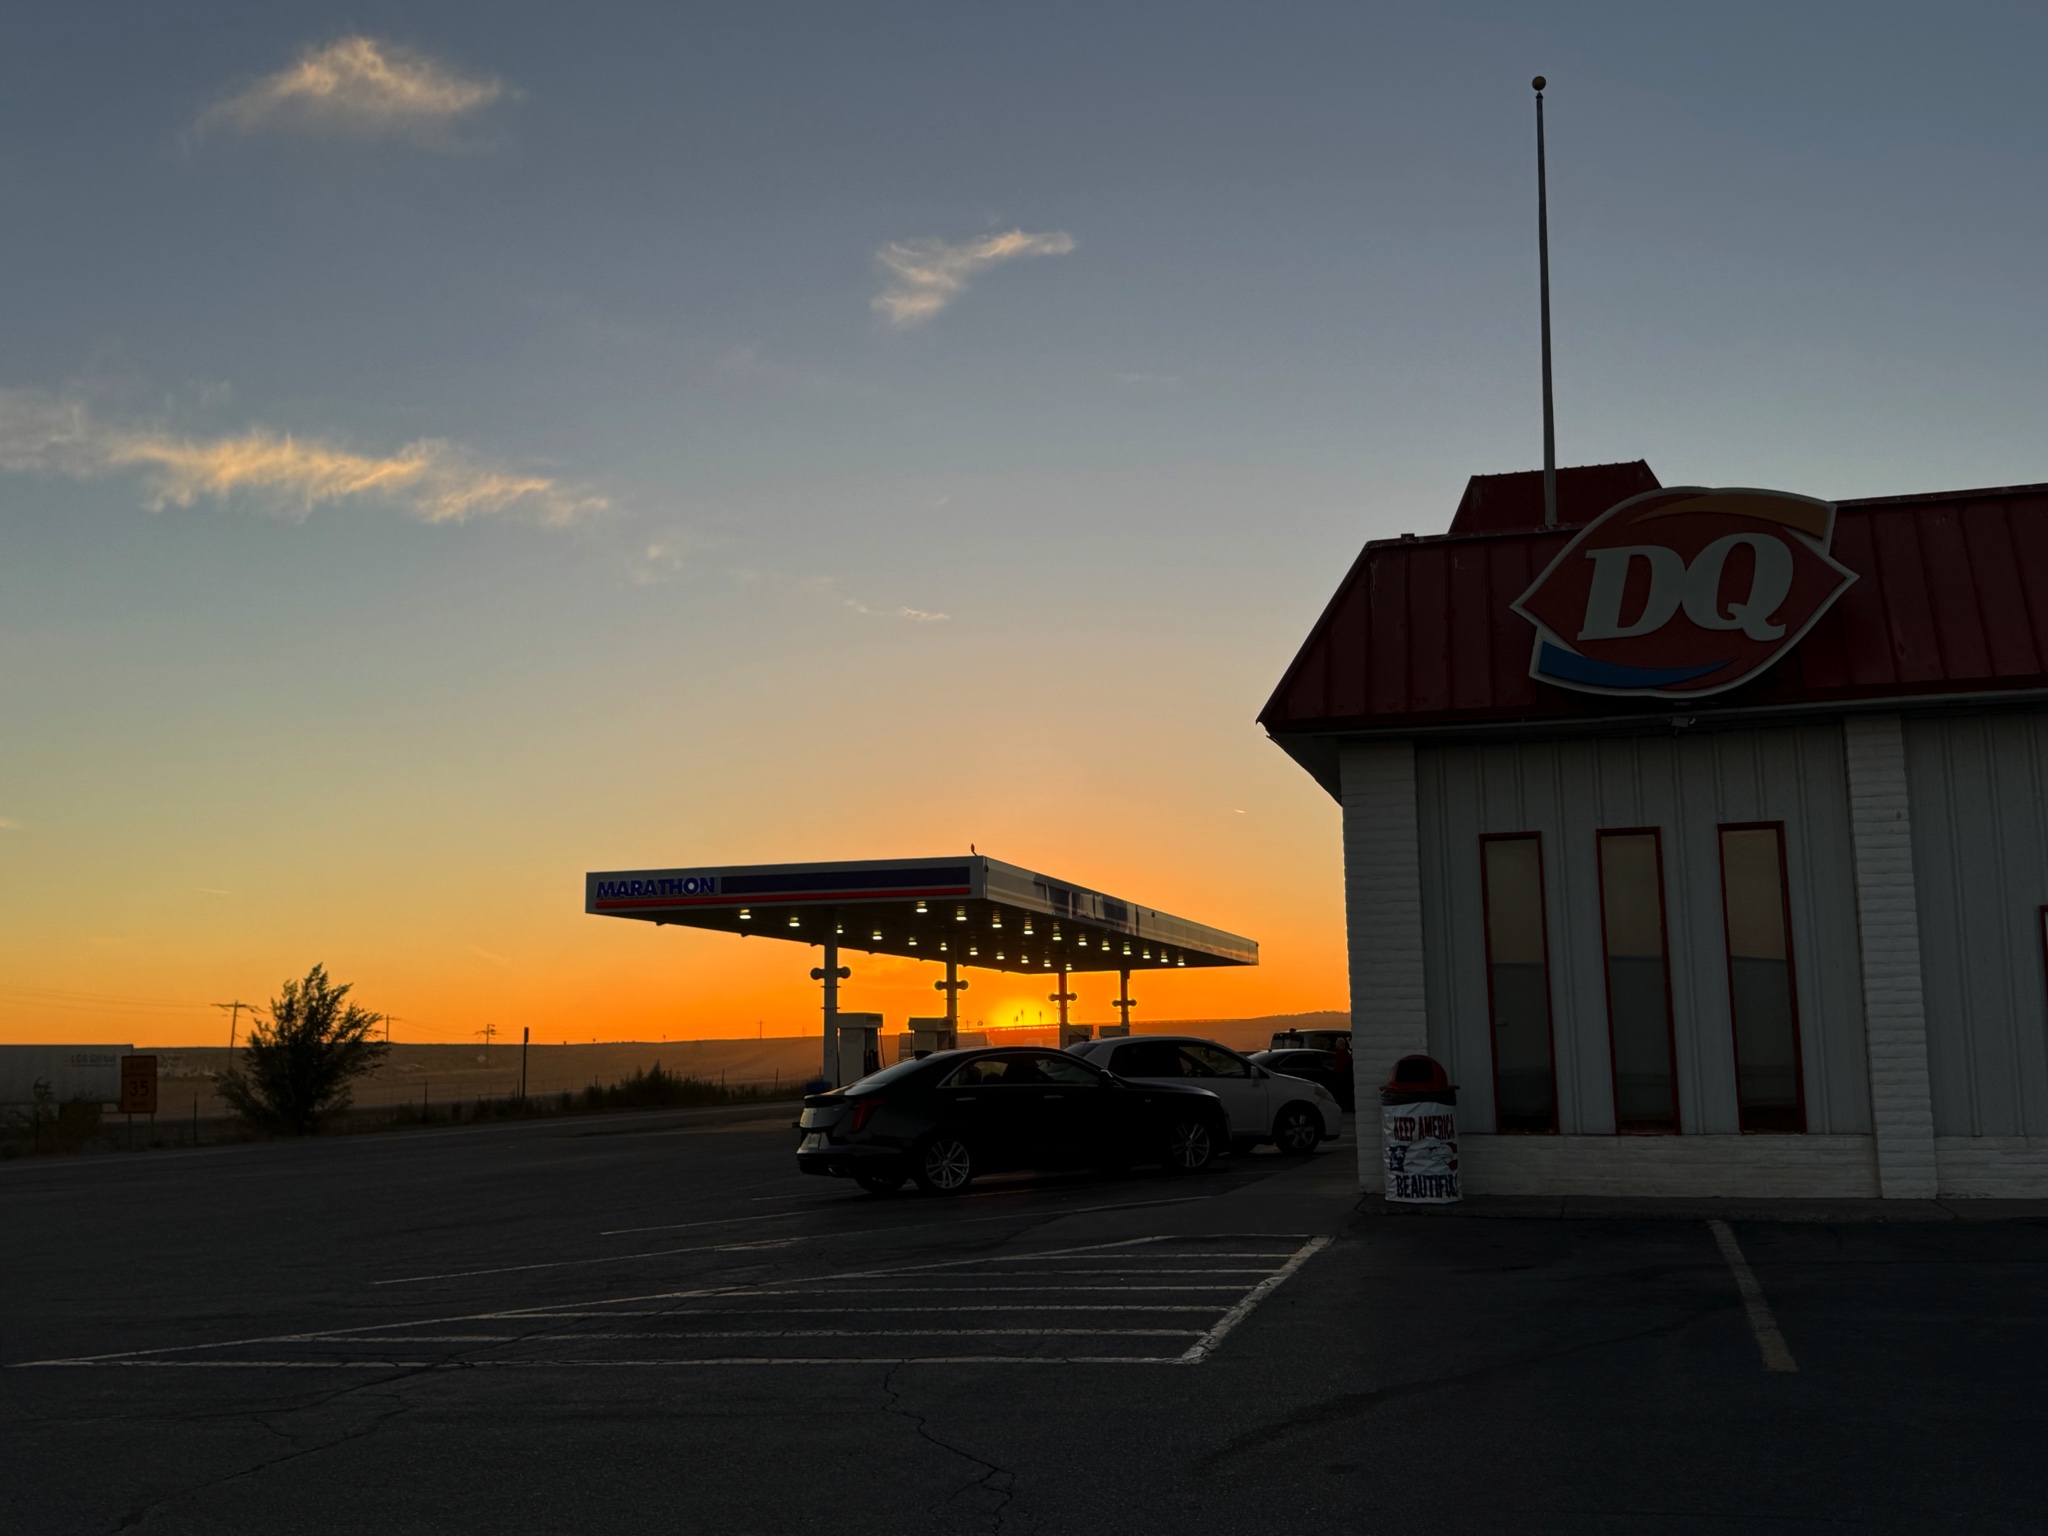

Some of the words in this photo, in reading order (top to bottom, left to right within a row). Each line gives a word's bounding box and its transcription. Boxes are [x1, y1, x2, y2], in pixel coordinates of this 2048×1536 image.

[1576, 532, 1793, 642] DQ
[596, 877, 715, 898] MARATHON
[129, 1080, 149, 1097] 35
[1394, 1116, 1416, 1141] KEEP
